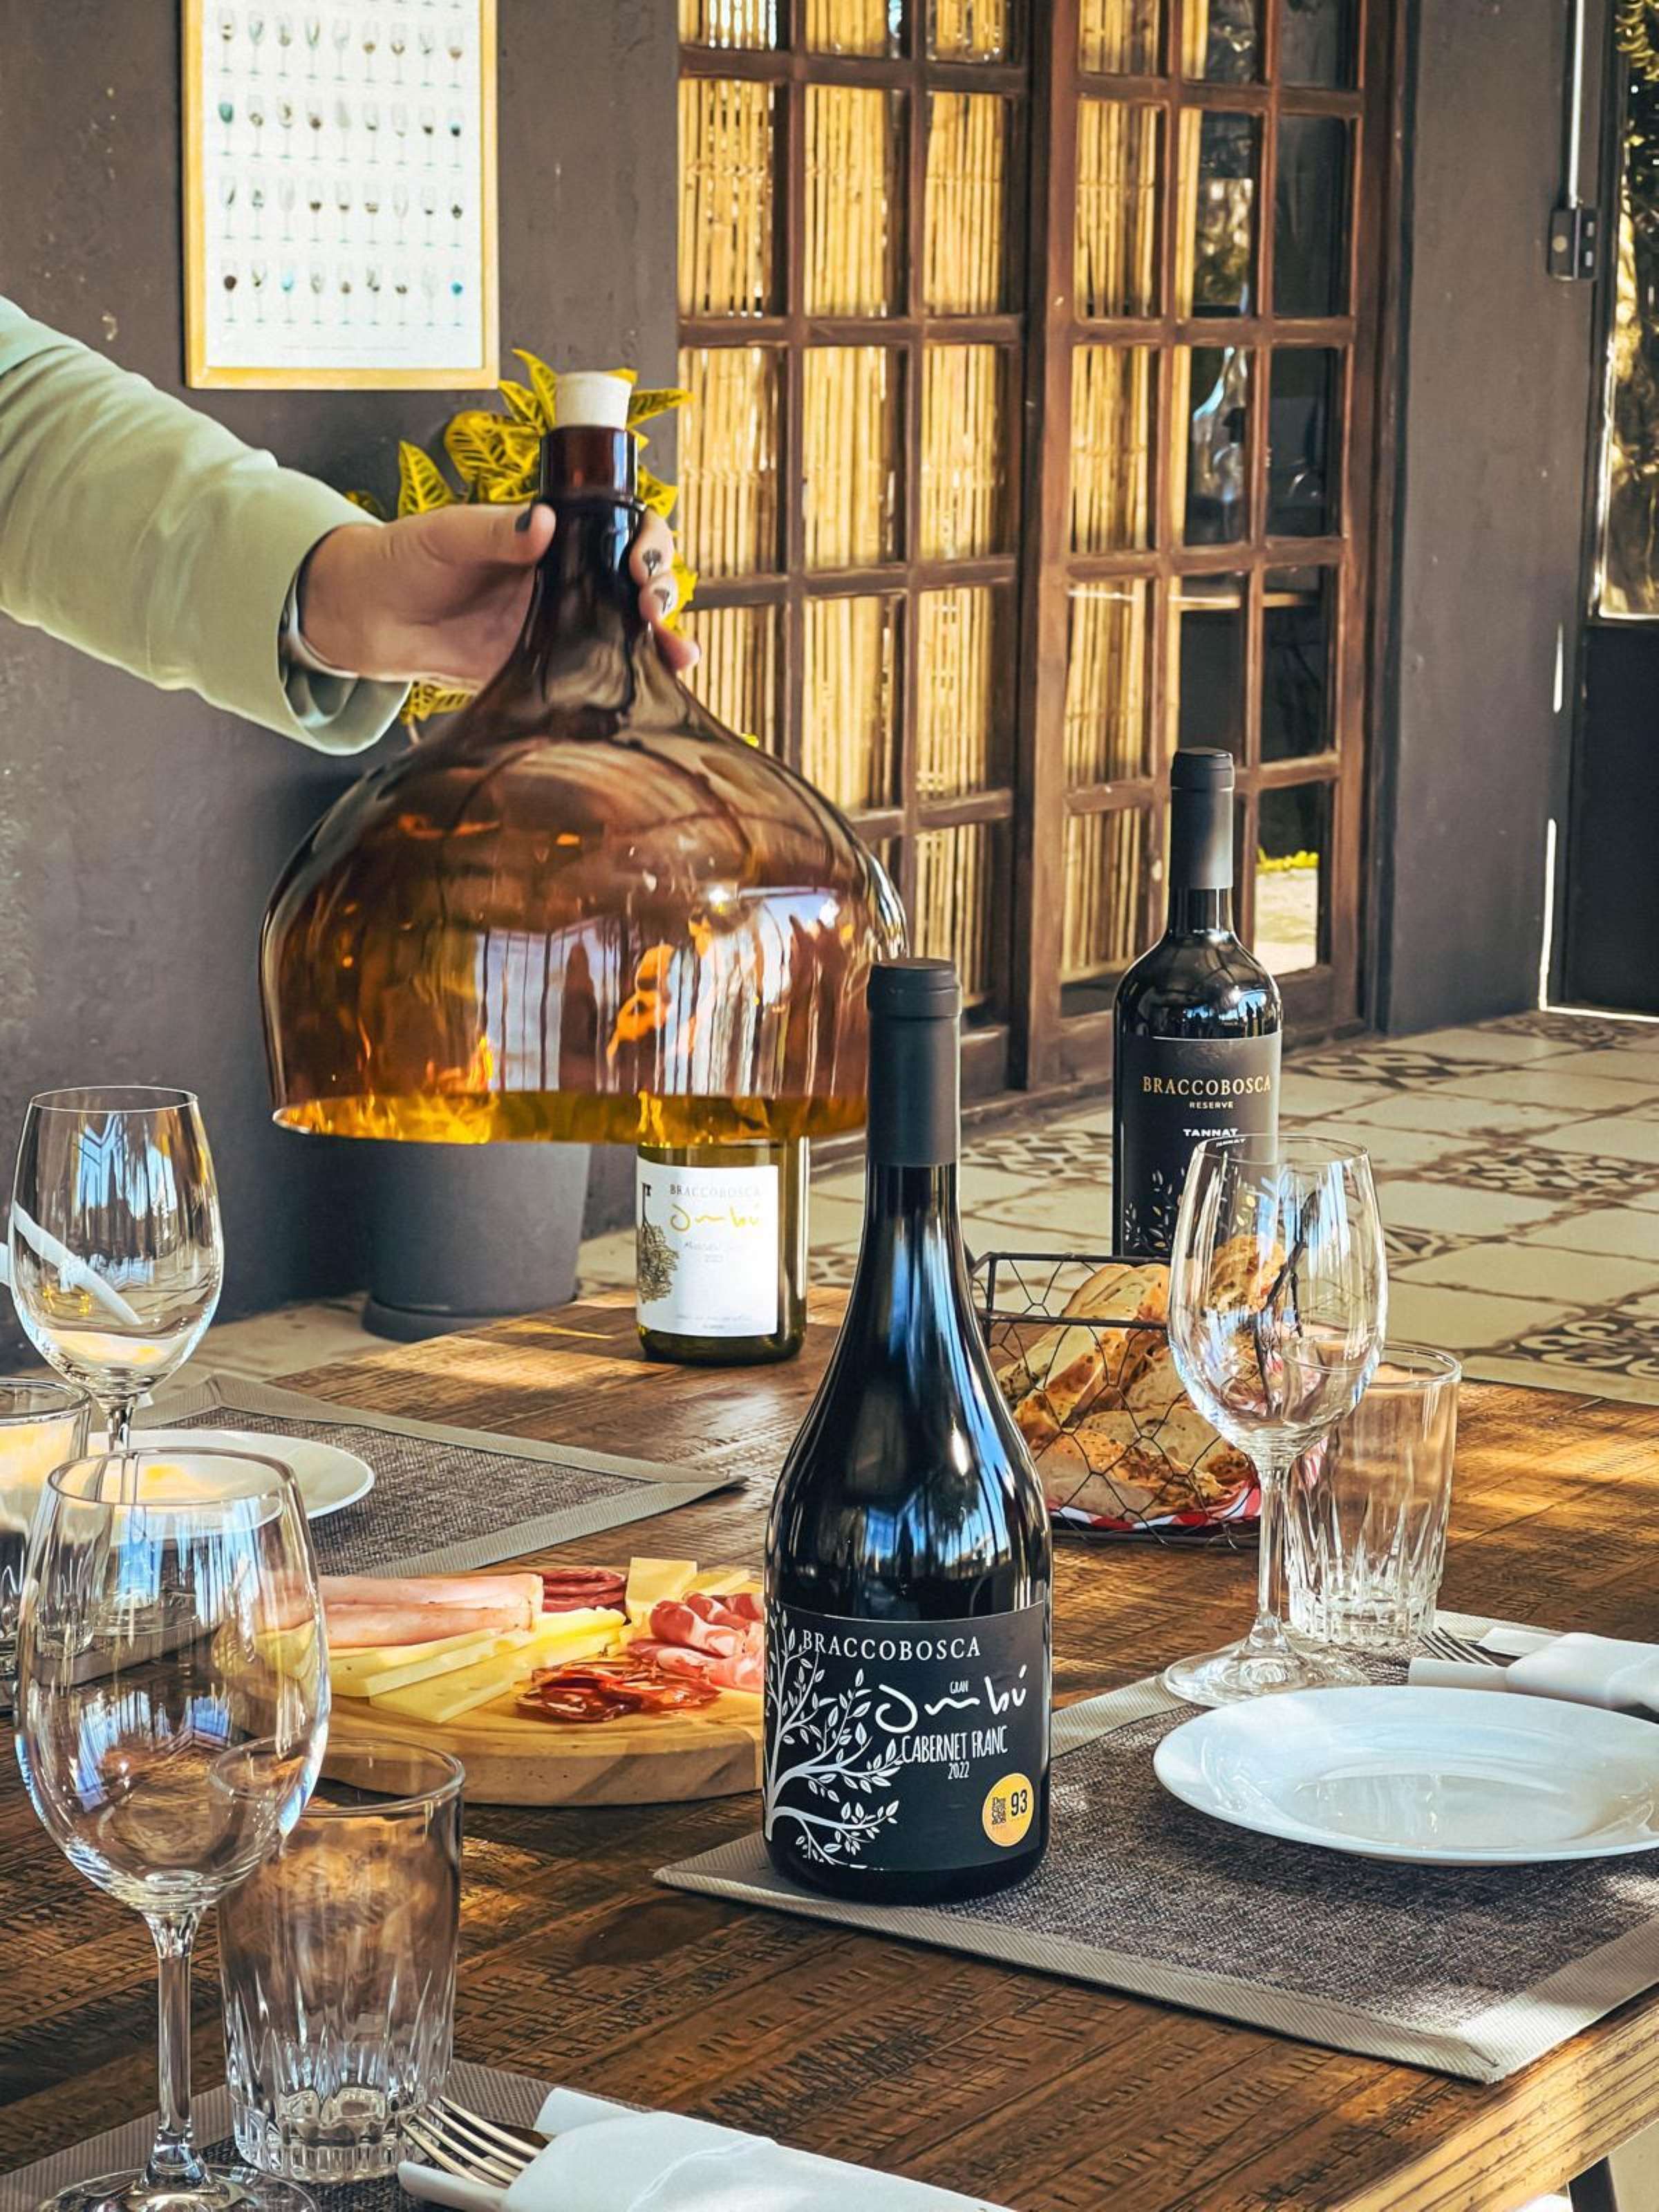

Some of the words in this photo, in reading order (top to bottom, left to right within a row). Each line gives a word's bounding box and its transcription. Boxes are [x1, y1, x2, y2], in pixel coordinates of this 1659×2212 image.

[1143, 1075, 1271, 1095] BRACCOBOSCA
[1189, 1101, 1234, 1109] RESERVE
[1183, 1128, 1239, 1137] TANNAT
[803, 1630, 981, 1661] BRACCOBOSCA
[950, 1680, 969, 1694] GRAN
[901, 1733, 968, 1764] CABERNET
[973, 1725, 1009, 1759] FRANC
[948, 1761, 970, 1780] 2022
[1011, 1789, 1027, 1816] 93
